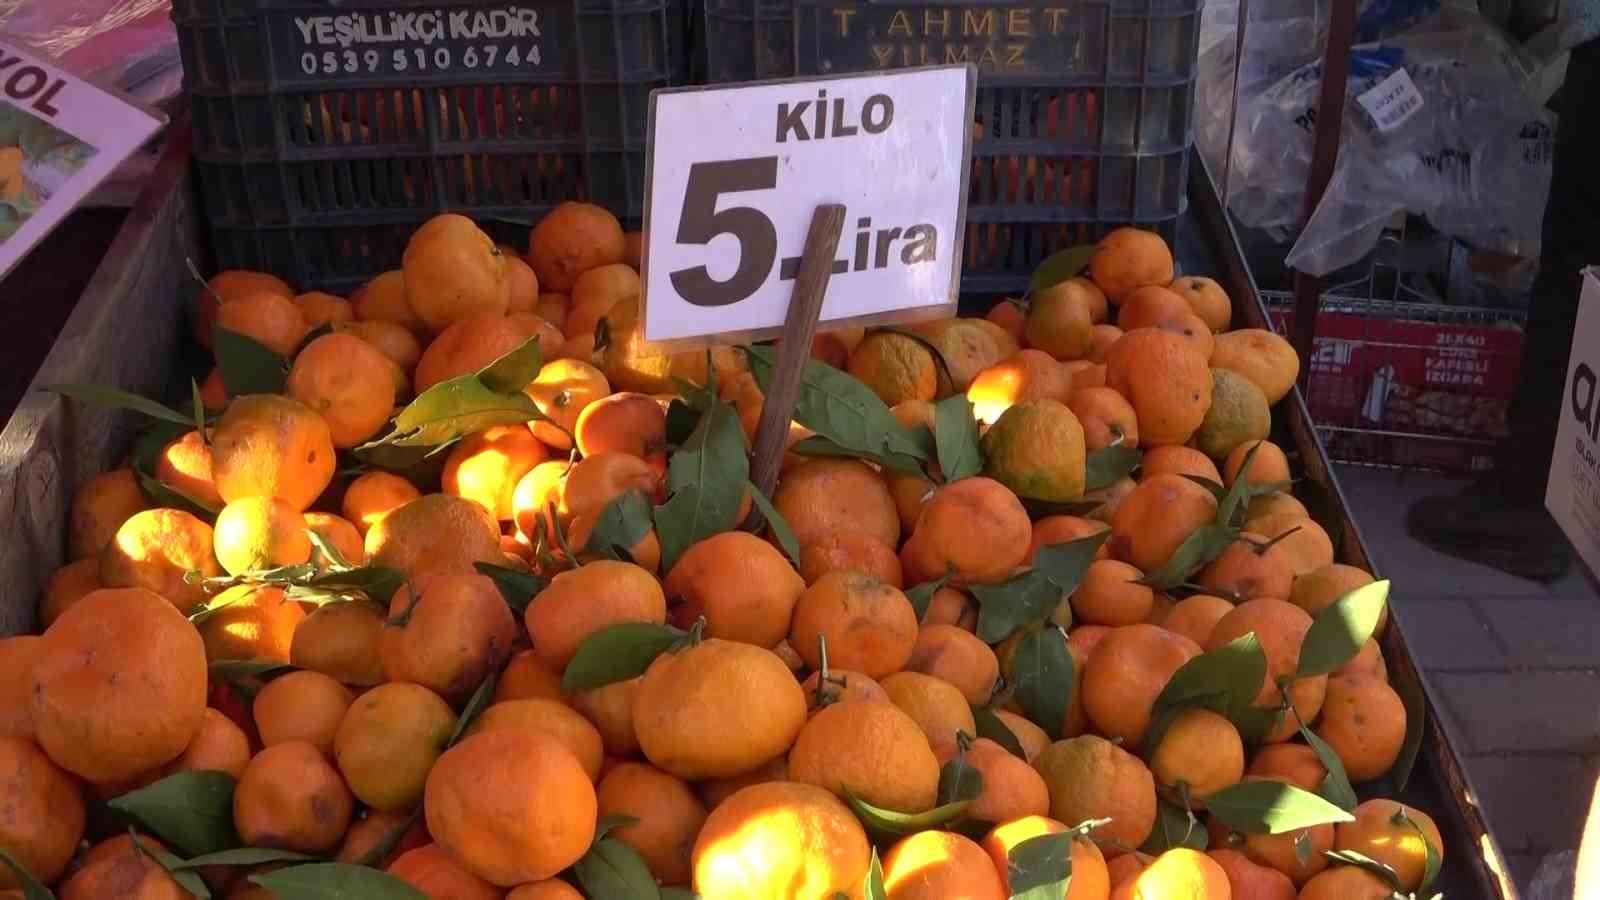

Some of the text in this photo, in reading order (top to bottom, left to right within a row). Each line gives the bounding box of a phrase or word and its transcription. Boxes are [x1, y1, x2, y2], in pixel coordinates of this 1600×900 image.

[887, 8, 1070, 37] AHMET
[301, 45, 541, 75] 0539 510 6744
[871, 44, 1026, 66] YILMAZ
